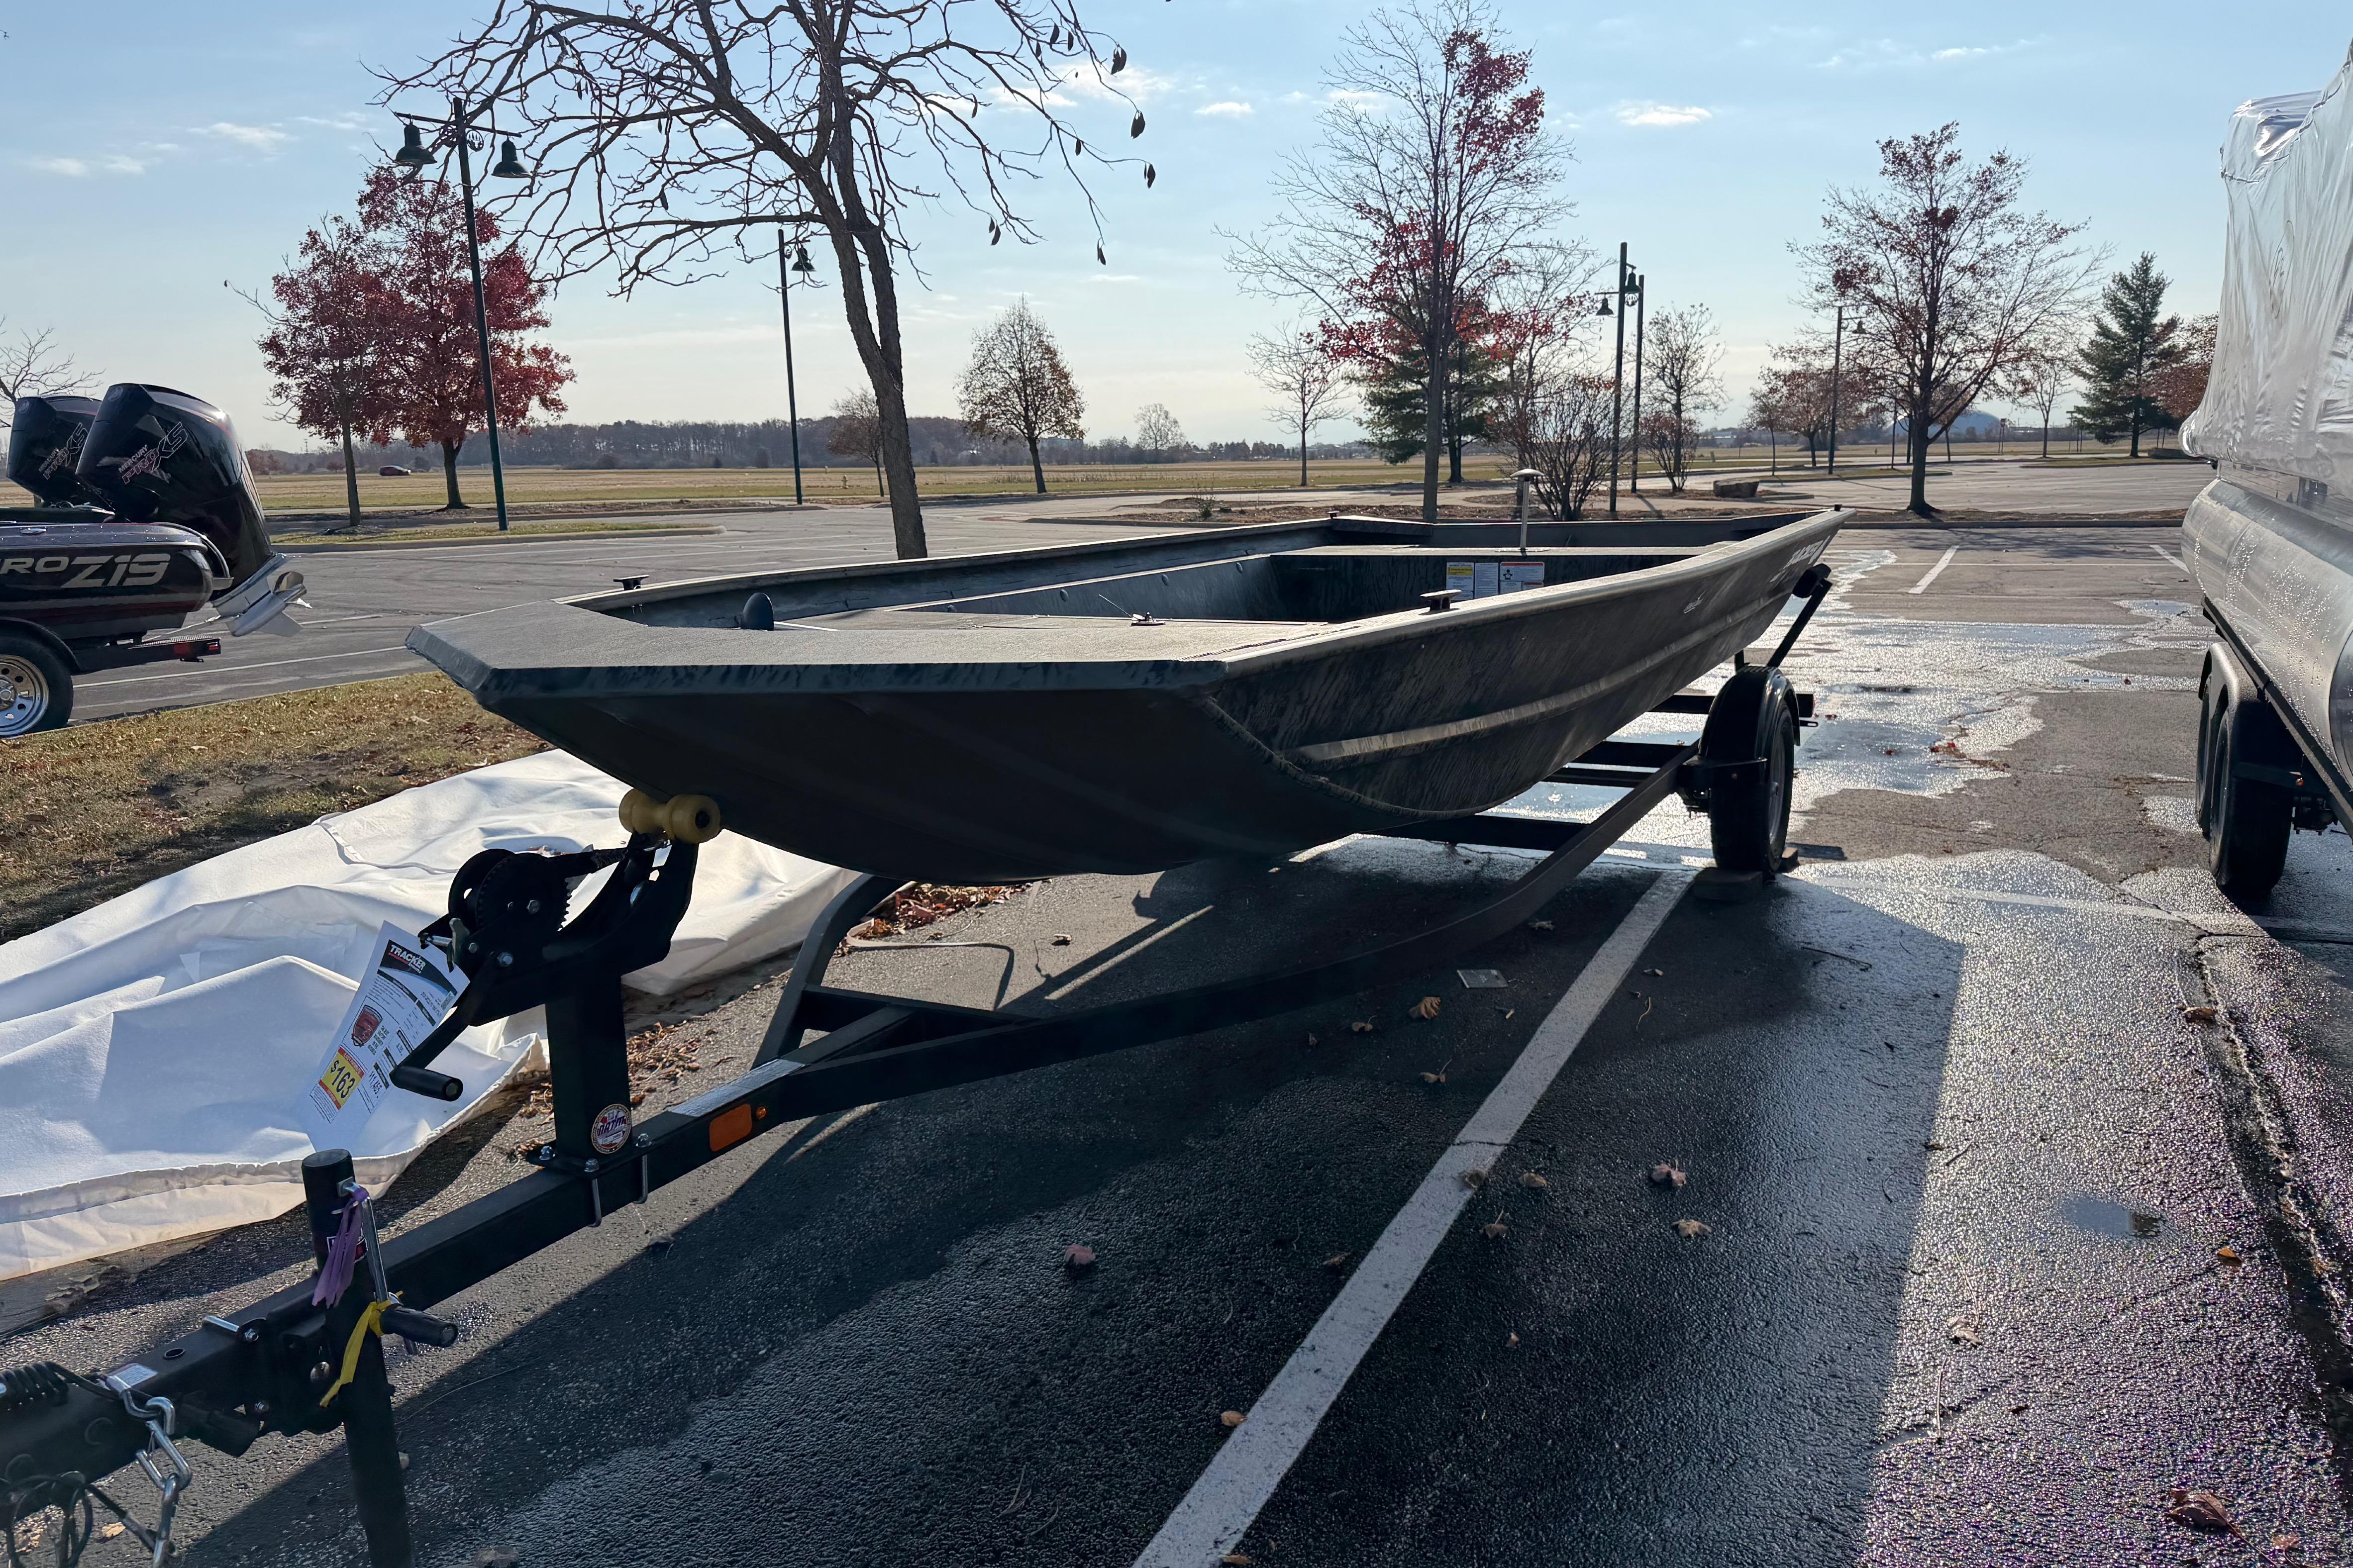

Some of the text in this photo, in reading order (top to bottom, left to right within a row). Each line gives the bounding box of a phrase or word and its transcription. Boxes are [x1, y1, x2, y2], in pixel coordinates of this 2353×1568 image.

[118, 444, 149, 473] MERCURY
[121, 421, 188, 485] PRO XS
[0, 553, 171, 588] RO Z19
[389, 944, 426, 971] TRACKER
[330, 1060, 356, 1099] $163
